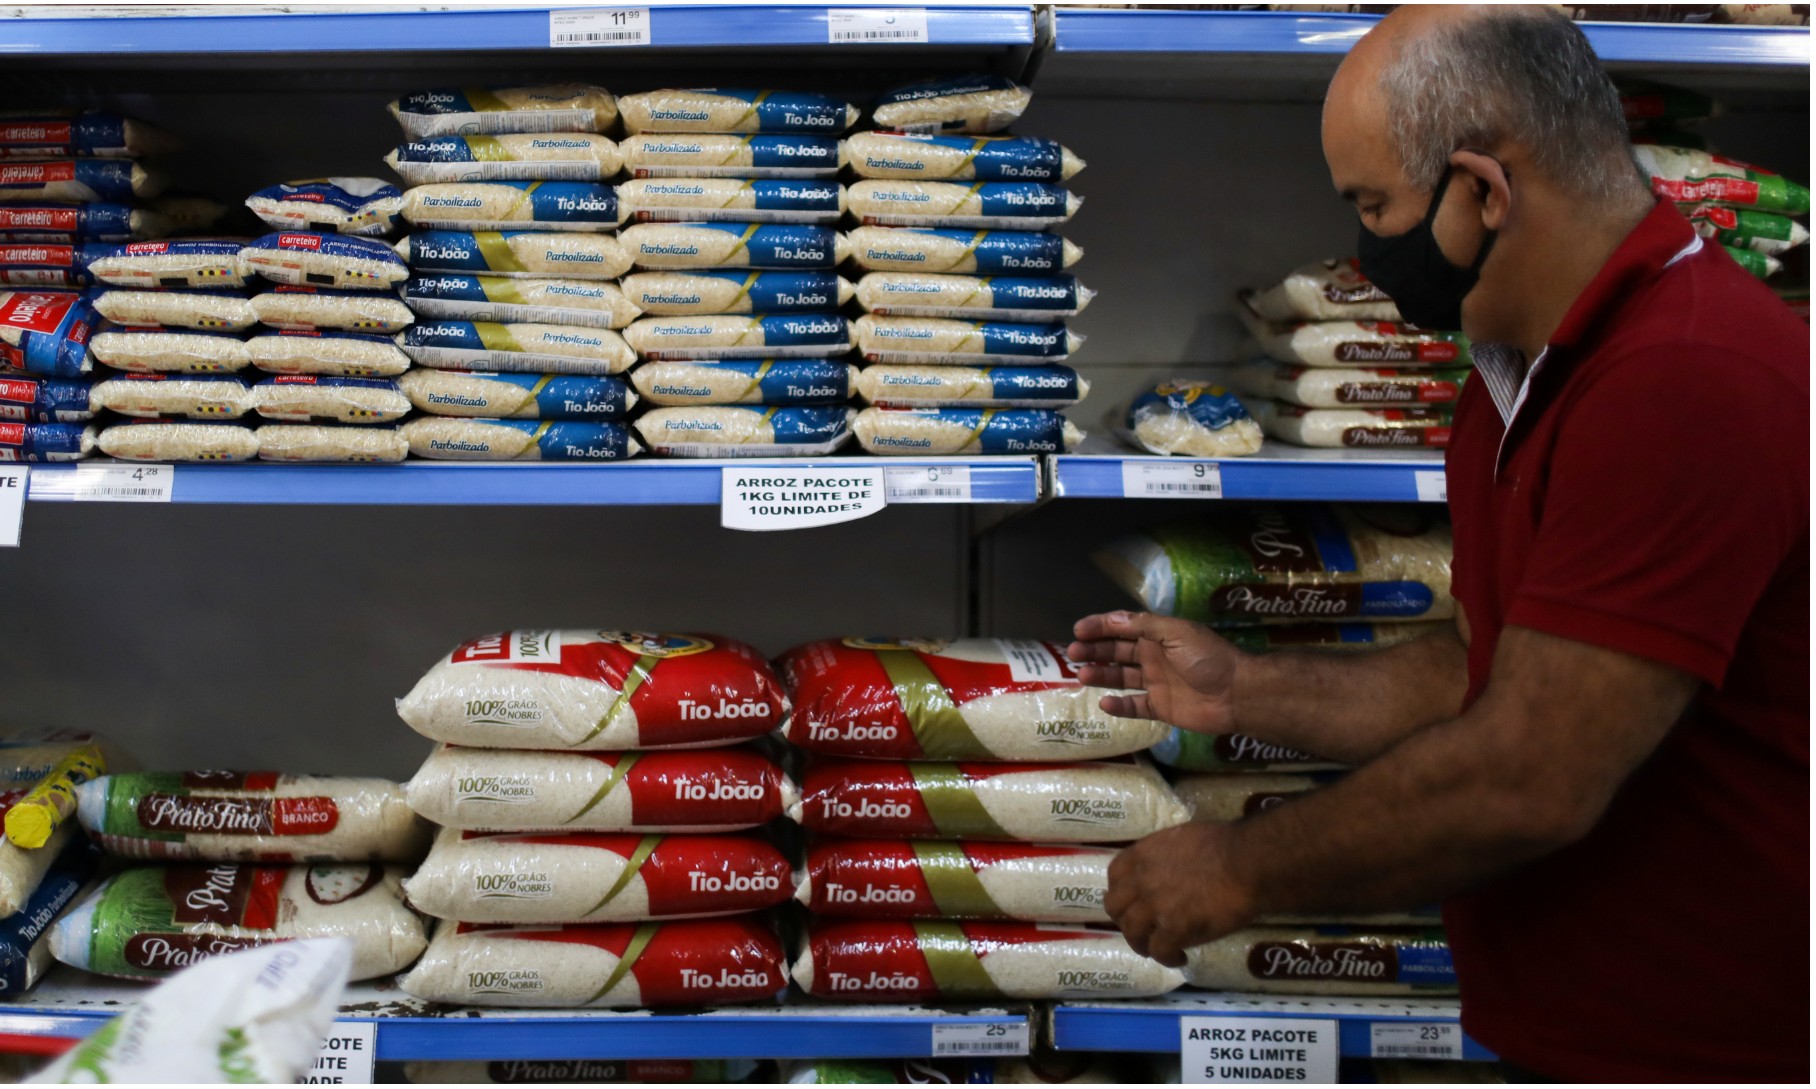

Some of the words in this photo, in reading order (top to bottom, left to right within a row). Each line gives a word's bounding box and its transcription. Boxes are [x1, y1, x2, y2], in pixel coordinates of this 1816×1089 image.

[651, 110, 708, 120] Parboilizado
[785, 113, 802, 124] Tio
[804, 115, 834, 125] João
[6, 128, 45, 138] carreteiro
[408, 143, 426, 151] Tio
[428, 143, 456, 152] João
[533, 140, 590, 148] Parboilizado
[643, 144, 701, 153] Parboilizado
[778, 145, 794, 155] Tio
[796, 145, 827, 156] João
[866, 158, 924, 170] Parboilizado
[1001, 164, 1018, 176] Tio
[1019, 166, 1050, 177] João
[645, 185, 703, 194] Parboilizado
[780, 188, 798, 198] Tio
[424, 197, 482, 207] Parboilizado
[873, 192, 929, 202] Parboilizado
[1006, 193, 1024, 204] Tio
[1026, 193, 1055, 205] João
[558, 199, 574, 210] Tio
[576, 199, 606, 211] João
[11, 213, 51, 224] carreteiro
[130, 243, 164, 251] carreteiro
[282, 237, 317, 246] carreteiro
[6, 250, 47, 260] carreteiro
[420, 246, 436, 258] Tio
[439, 247, 469, 259] João
[640, 244, 698, 255] Parboilizado
[774, 248, 791, 258] Tio
[793, 248, 824, 260] João
[546, 252, 604, 262] Parboilizado
[867, 250, 926, 262] Parboilizado
[1002, 256, 1019, 267] Tio
[1021, 257, 1051, 268] João
[418, 279, 436, 287] Tio
[437, 278, 468, 289] João
[883, 283, 941, 292] Parboilizado
[546, 285, 604, 297] Parboilizado
[1018, 286, 1035, 297] Tio
[1036, 287, 1067, 298] João
[643, 294, 700, 304] Parboilizado
[777, 294, 794, 304] Tio
[796, 294, 827, 305] João
[416, 326, 433, 336] Tio
[435, 326, 465, 337] João
[654, 326, 712, 335] Parboilizado
[788, 323, 806, 333] Tio
[808, 323, 838, 333] João
[875, 327, 933, 338] Parboilizado
[544, 333, 602, 346] Parboilizado
[1010, 333, 1027, 343] Tio
[1344, 345, 1382, 360] Prato
[1382, 345, 1412, 360] Fino
[884, 376, 942, 385] Parboilizado
[1019, 377, 1036, 387] Tio
[1037, 377, 1067, 388] João
[653, 386, 711, 396] Parboilizado
[787, 386, 804, 396] Tio
[807, 386, 837, 396] João
[1344, 385, 1382, 400] Prato
[1383, 385, 1412, 400] Fino
[428, 394, 487, 407] Parboilizado
[564, 401, 581, 411] Tio
[584, 402, 614, 413] João
[873, 436, 931, 447] Parboilizado
[1351, 429, 1390, 444] Prato
[1390, 429, 1419, 444] Fino
[431, 440, 489, 452] Parboilizado
[1007, 439, 1024, 449] Tio
[1026, 439, 1056, 451] João
[566, 446, 583, 456] Tio
[586, 447, 616, 458] João
[736, 478, 797, 487] ARROZ
[804, 478, 873, 487] PACOTE
[739, 492, 774, 501] 1KG
[782, 492, 842, 501] LIMITE
[849, 491, 871, 499] DE
[749, 503, 862, 515] 10UNIDADES
[1226, 586, 1295, 614] Prato
[1294, 588, 1347, 615] Fino
[466, 700, 507, 717] 100%
[508, 699, 538, 709] GRÃOS
[678, 700, 711, 720] Tio
[714, 698, 770, 719] João
[507, 710, 542, 720] NOBRES
[808, 722, 840, 741] Tio
[842, 721, 897, 741] João
[1036, 720, 1075, 736] 100%
[1075, 730, 1111, 740] NOBRES
[458, 777, 499, 793] 100%
[674, 780, 706, 799] Tio
[708, 780, 764, 800] João
[500, 787, 535, 796] NOBRES
[823, 799, 852, 818] Tio
[854, 798, 911, 818] João
[1051, 800, 1091, 815] 100%
[1092, 798, 1122, 809] GRÃOS
[149, 800, 215, 828] Prato
[213, 801, 261, 830] Fino
[282, 812, 329, 824] BRANCO
[1091, 809, 1126, 819] NOBRES
[475, 874, 516, 890] 100%
[517, 871, 547, 882] GRÃOS
[689, 872, 721, 891] Tio
[724, 871, 779, 891] João
[517, 883, 551, 893] NOBRES
[826, 883, 858, 902] Tio
[860, 885, 915, 903] João
[1054, 887, 1093, 901] 100%
[19, 923, 38, 941] Tio
[1264, 947, 1333, 977] Prato
[1332, 948, 1385, 977] Fino
[468, 972, 508, 988] 100%
[509, 969, 539, 980] GRÃOS
[680, 970, 712, 988] Tio
[715, 969, 769, 988] João
[1058, 972, 1098, 986] 100%
[1099, 970, 1128, 981] GRÃOS
[509, 981, 543, 990] NOBRES
[830, 973, 861, 990] Tio
[864, 972, 919, 990] João
[1189, 1029, 1246, 1041] ARROZ
[1252, 1029, 1317, 1043] PACOTE
[320, 1038, 363, 1050] COTE
[1210, 1048, 1244, 1060] 5KG
[1250, 1048, 1306, 1061] LIMITE
[1206, 1066, 1214, 1078] 5
[1221, 1067, 1306, 1080] UNIDADES
